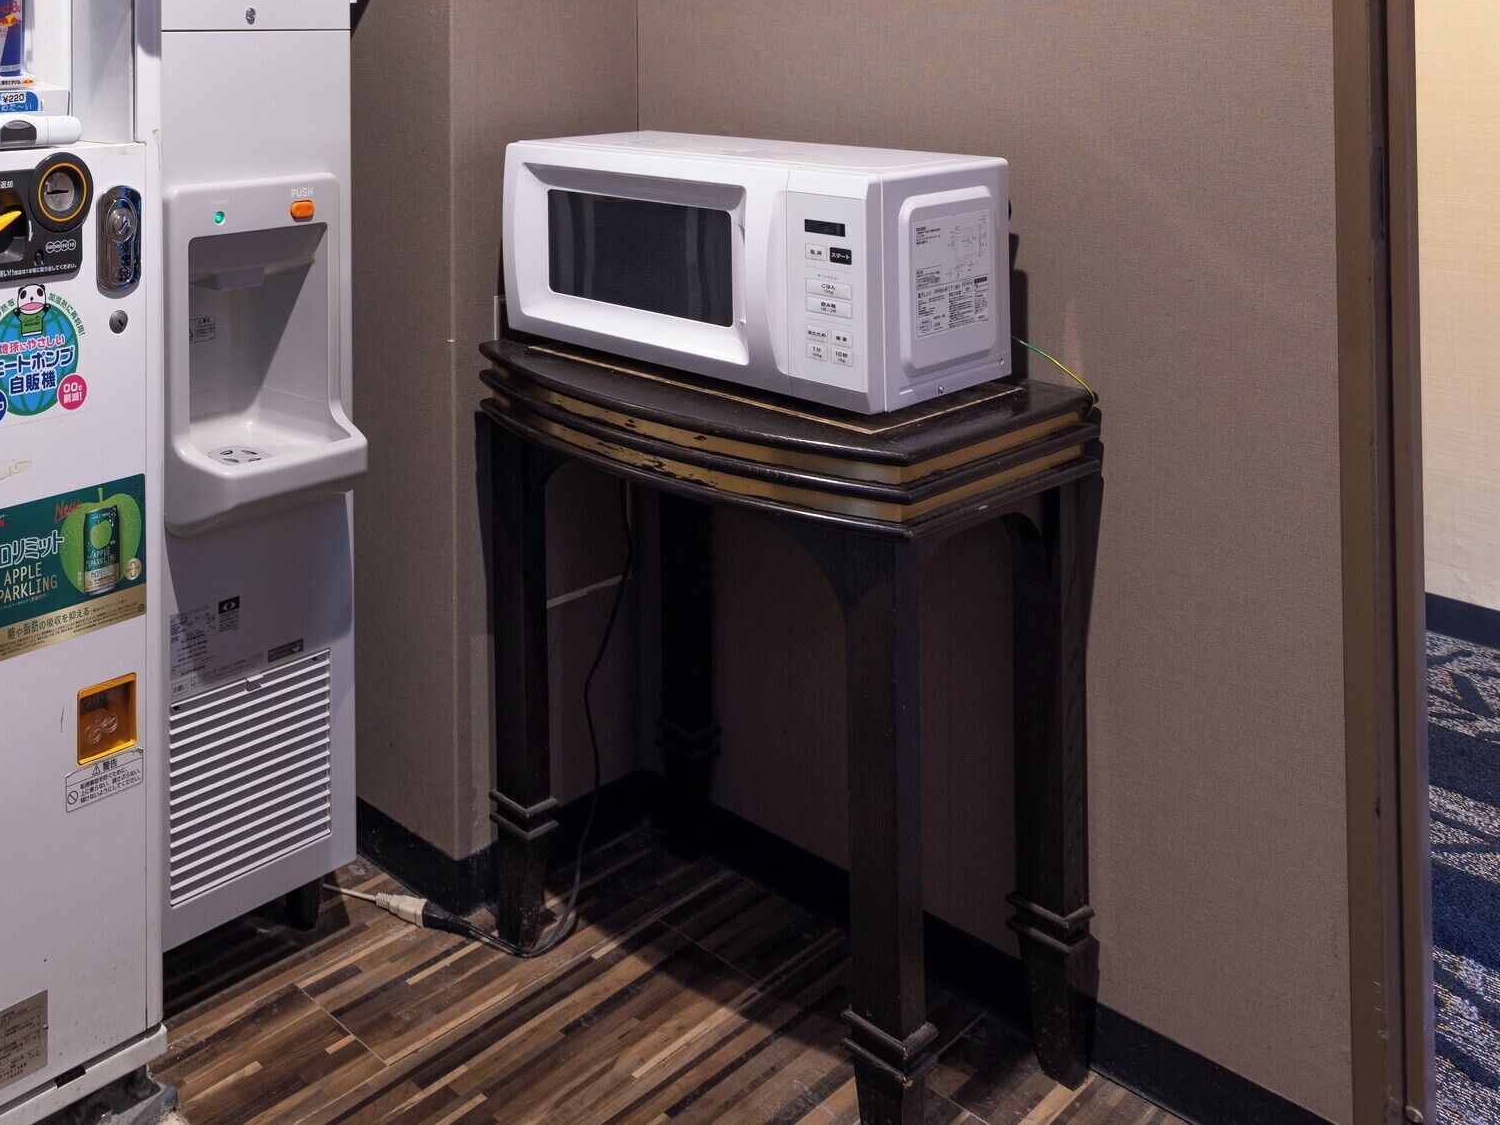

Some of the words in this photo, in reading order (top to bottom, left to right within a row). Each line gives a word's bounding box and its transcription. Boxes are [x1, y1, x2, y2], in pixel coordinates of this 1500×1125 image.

[291, 188, 314, 198] PUSH
[831, 252, 850, 260] スタート
[821, 283, 836, 291] ごはん
[9, 369, 58, 395] 自販機
[3, 562, 43, 586] APPLE
[102, 759, 118, 772] 警告
